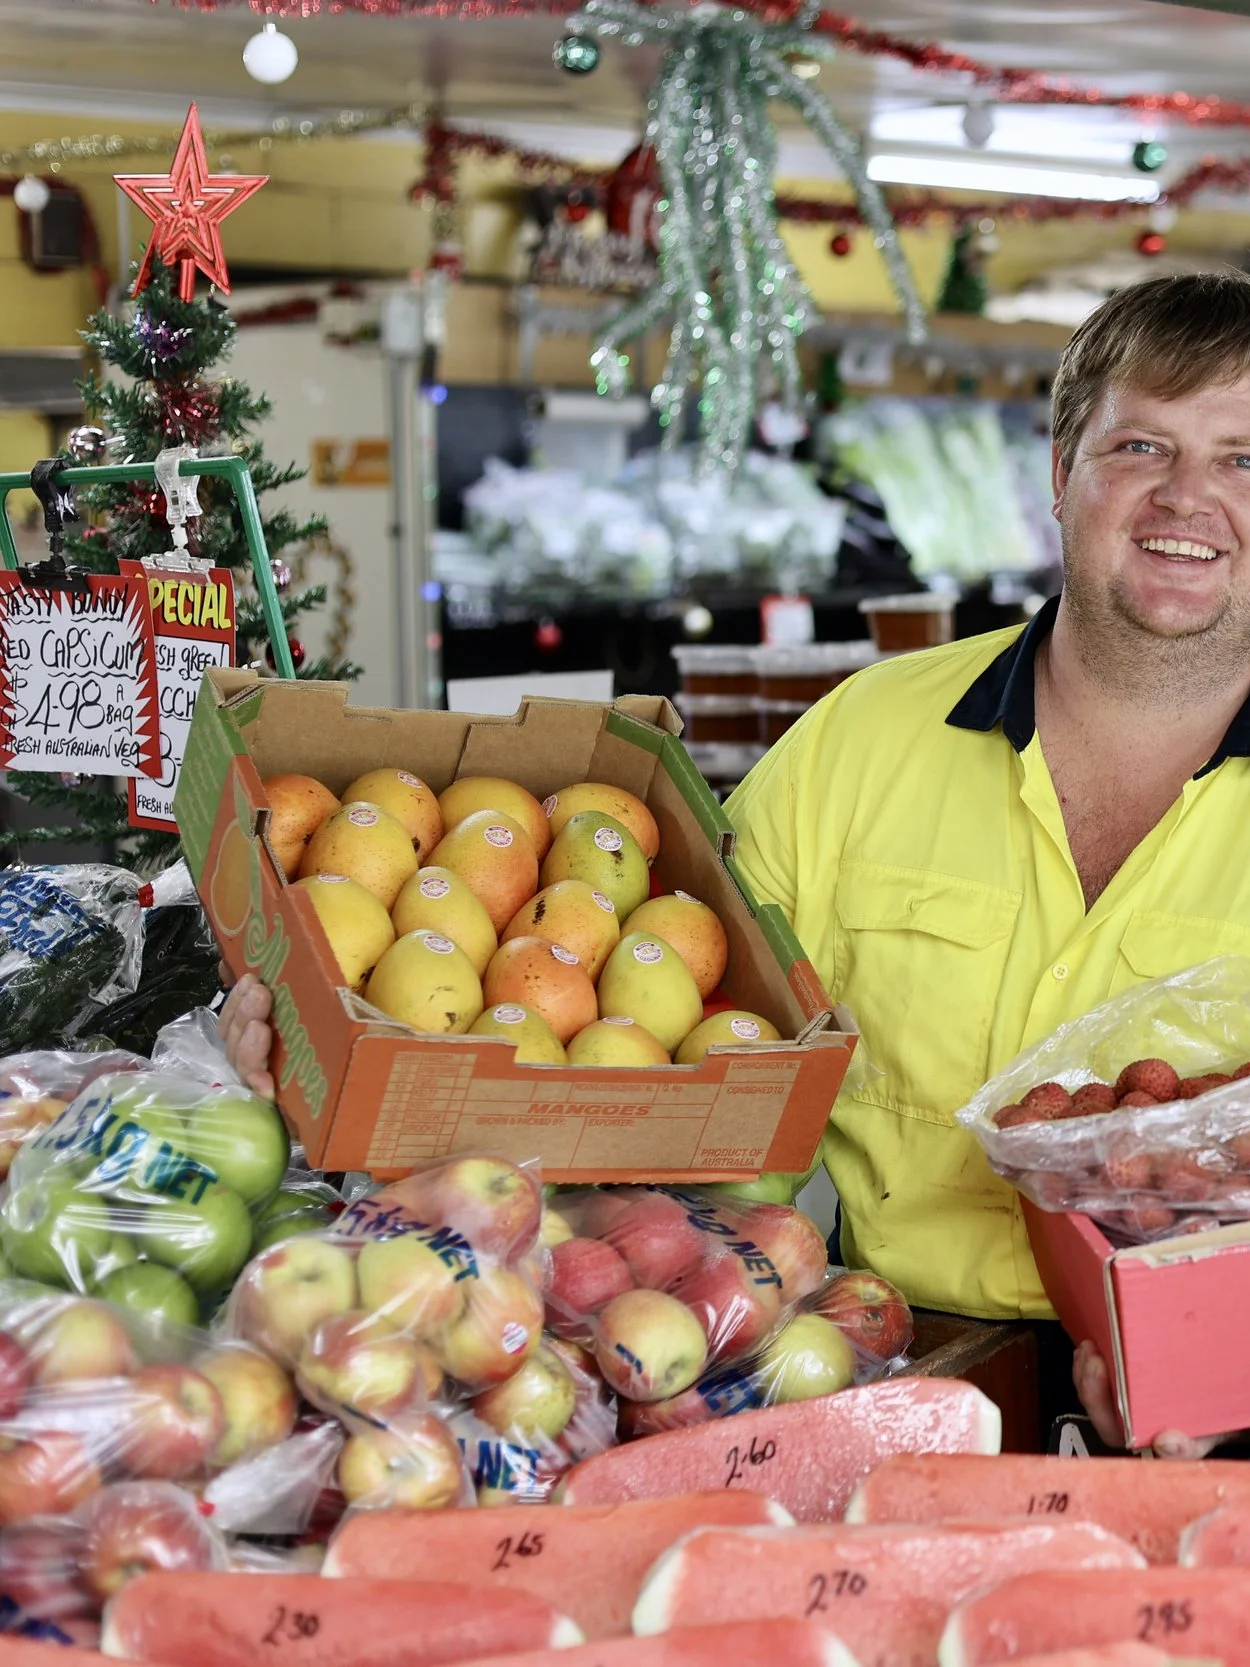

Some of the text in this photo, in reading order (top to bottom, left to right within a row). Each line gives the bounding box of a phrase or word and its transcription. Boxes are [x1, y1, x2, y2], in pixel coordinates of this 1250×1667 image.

[0, 586, 52, 617] TASTY
[148, 575, 232, 629] PECIAL
[155, 645, 176, 668] ESH
[161, 687, 197, 716] CCH
[5, 735, 41, 755] FRESH
[527, 1103, 652, 1117] MANGOES
[700, 1158, 755, 1168] AUSTRALIA
[701, 1149, 763, 1158] PRODUCT OF
[143, 1140, 219, 1206] NET
[724, 1241, 783, 1289] NET
